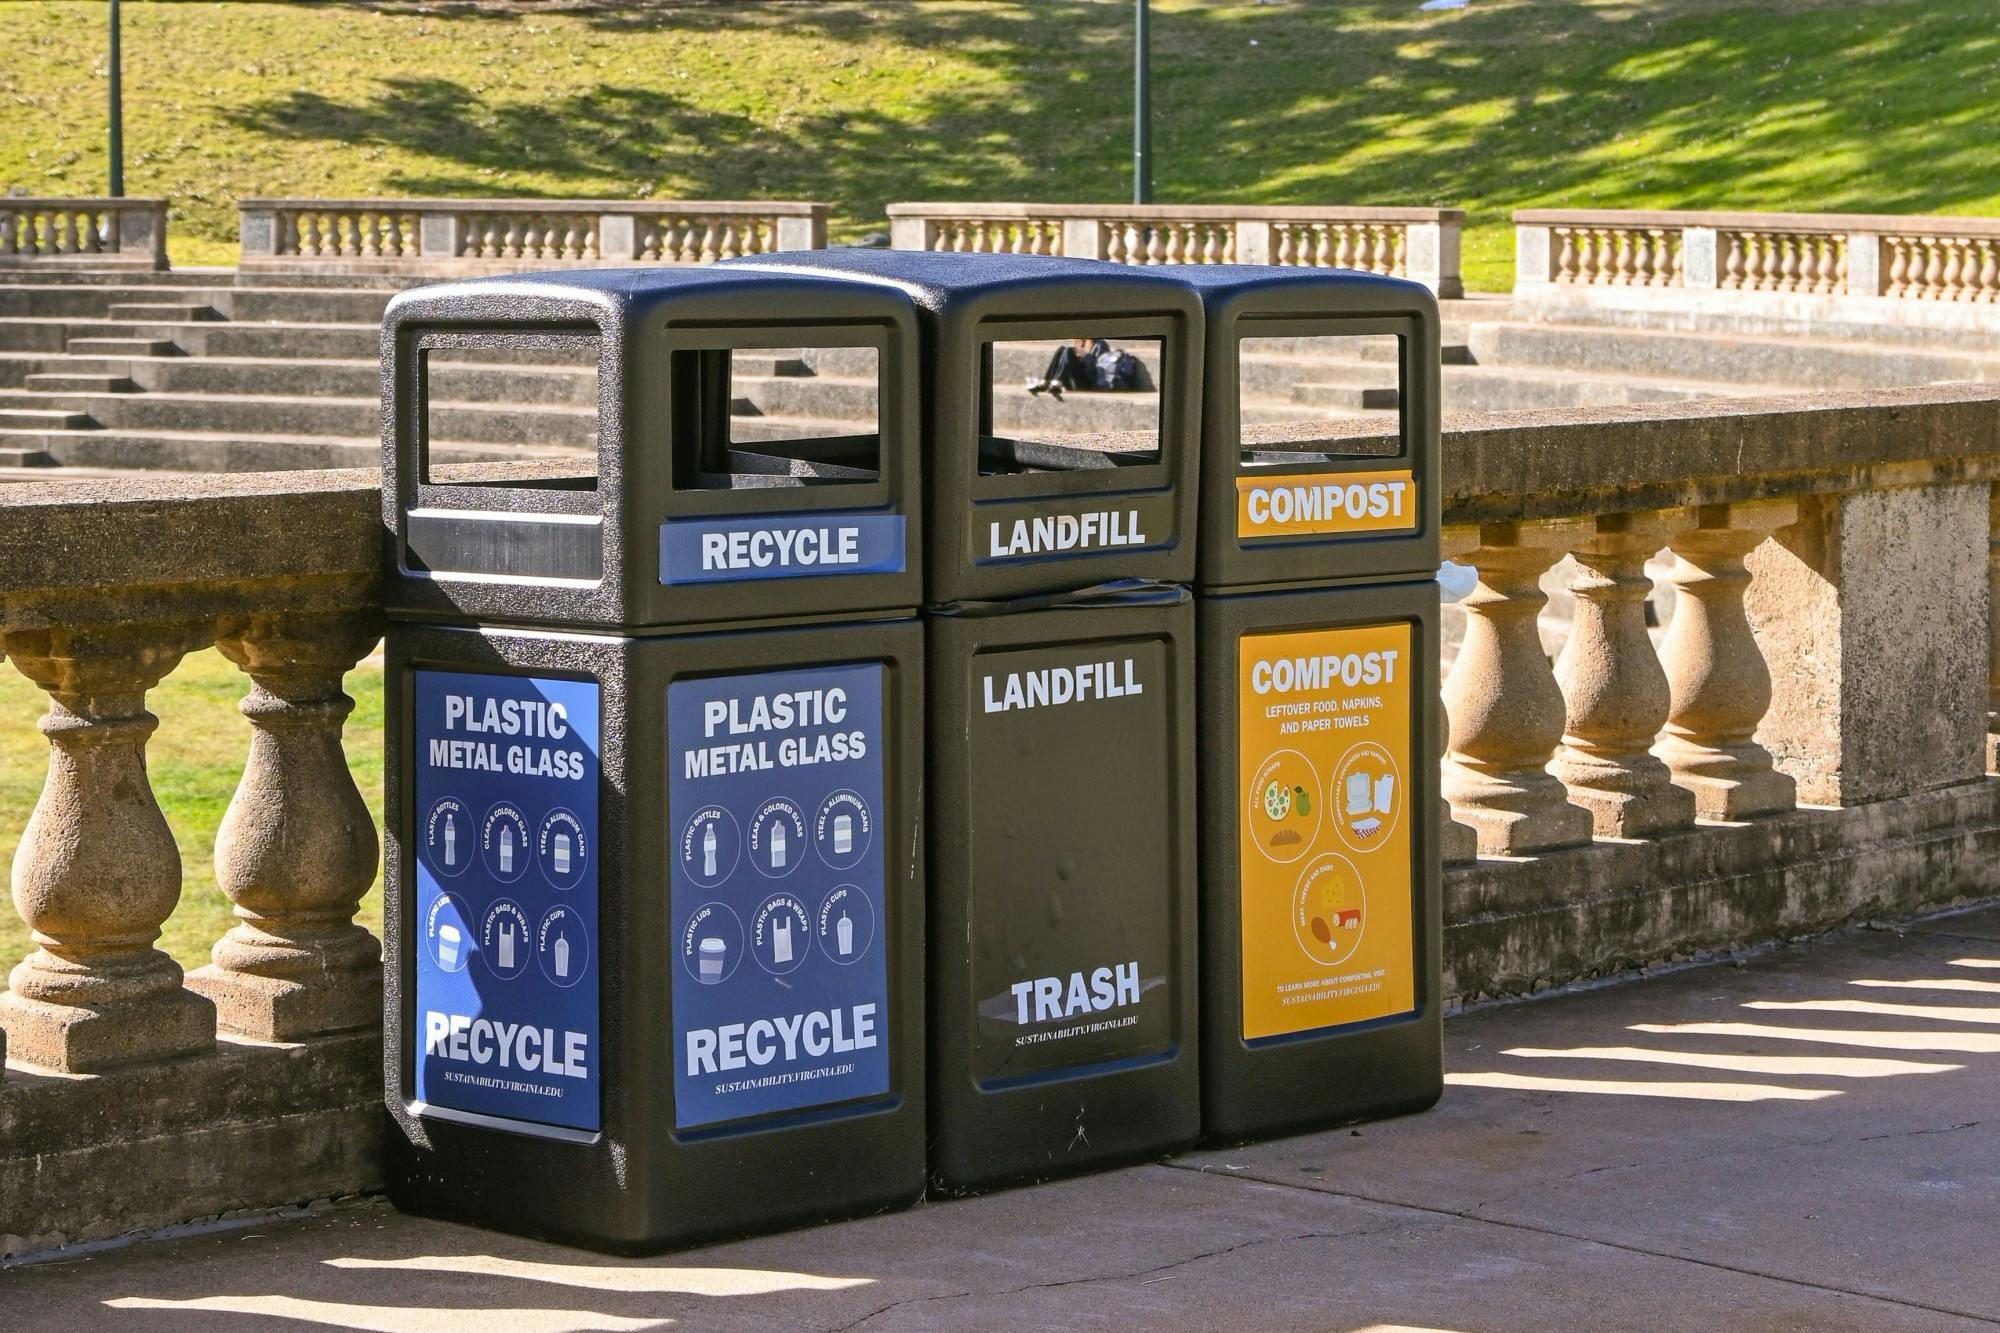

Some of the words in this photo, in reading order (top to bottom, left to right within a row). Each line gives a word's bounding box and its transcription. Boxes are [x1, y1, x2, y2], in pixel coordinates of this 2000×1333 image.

[1248, 482, 1406, 524] COMPOST
[702, 527, 858, 570] RECYCLE
[991, 510, 1146, 557] LANDFILL
[984, 659, 1142, 713] LANDFILL
[1252, 650, 1398, 694] COMPOST
[446, 695, 567, 740] PLASTIC
[705, 687, 846, 737] PLASTIC
[1266, 702, 1310, 718] LEFTOVER
[1342, 696, 1384, 711] NAPKINS,
[1280, 722, 1299, 735] AND
[1302, 718, 1331, 732] PAPER
[1334, 715, 1370, 729] TOWELS
[430, 739, 503, 772] METAL
[507, 746, 584, 780] GLASS
[685, 742, 773, 779] METAL
[779, 731, 866, 767] GLASS
[429, 812, 438, 846] PLASTIC
[437, 802, 459, 814] BOTTLES
[494, 808, 519, 821] COLORED
[518, 820, 528, 847] GLASS
[685, 825, 695, 861] PLASTIC
[694, 811, 720, 826] BOTTLES
[752, 822, 760, 850] CLEAR
[764, 803, 792, 815] COLORED
[792, 812, 803, 837] GLASS
[485, 912, 495, 946] PLASTIC
[495, 904, 510, 914] BAGS
[511, 907, 516, 915] &
[517, 912, 528, 942] WRAPS
[540, 919, 550, 952] PLASTIC
[550, 910, 565, 920] CUPS
[686, 920, 697, 955] PLASTIC
[696, 908, 711, 921] LIDS
[756, 910, 768, 946] PLASTIC
[767, 899, 785, 911] BAGS
[793, 903, 808, 932] WRAPS
[821, 902, 831, 936] PLASTIC
[830, 890, 847, 903] CUPS
[1011, 961, 1140, 1025] TRASH
[1321, 977, 1339, 986] ABOUT
[426, 1011, 587, 1079] RECYCLE
[686, 1003, 877, 1077] RECYCLE
[1015, 1015, 1139, 1046] SUSTAINABILITY.VIRGINIA.EDU
[444, 1072, 564, 1098] SUSTAINABILITY.VIRGINIA.EDU
[715, 1063, 856, 1094] SUSTAINABILITY.VIRGINIA.EDU
